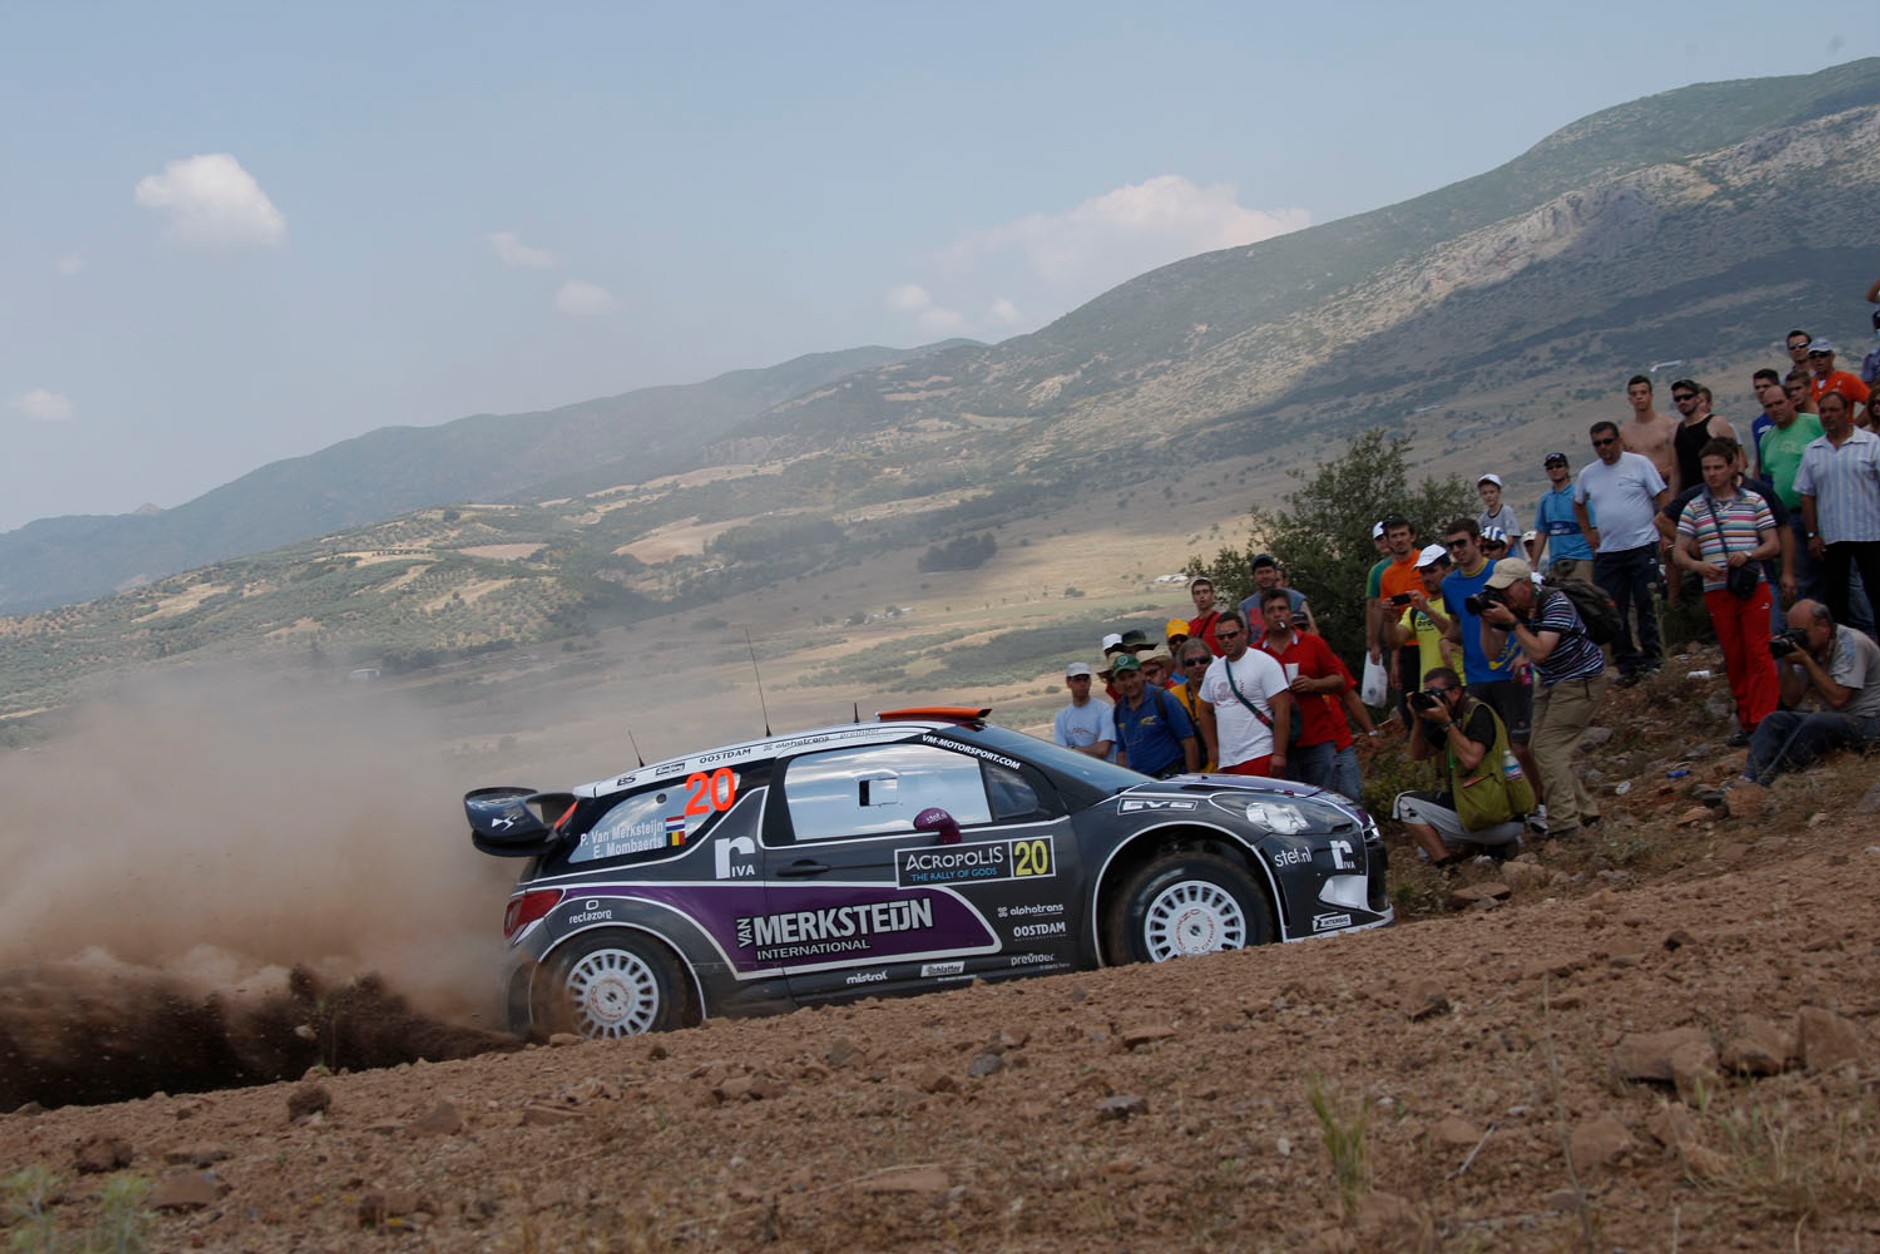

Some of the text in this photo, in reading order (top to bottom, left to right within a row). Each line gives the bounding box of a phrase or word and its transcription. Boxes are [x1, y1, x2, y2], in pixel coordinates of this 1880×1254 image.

[699, 748, 751, 764] OOSTDAM
[922, 734, 1021, 770] VM-MOTORSPORT.COM
[684, 767, 736, 816] 20
[580, 819, 663, 847] P. Van Merksteijn
[593, 837, 663, 859] E. Mombaerts
[905, 846, 1004, 871] ACROPOLIS
[1014, 840, 1048, 876] 20
[1274, 846, 1312, 867] stef.nl
[911, 867, 997, 882] THE RALLY OF GODS
[569, 909, 612, 924] reclazorg
[1010, 904, 1064, 916] alphatrans
[736, 918, 752, 948] VAN
[753, 898, 933, 947] MERKSTEIJN
[1013, 921, 1067, 937] OOSTDAM
[757, 939, 870, 961] INTERNATIONAL
[846, 970, 887, 985] mistral
